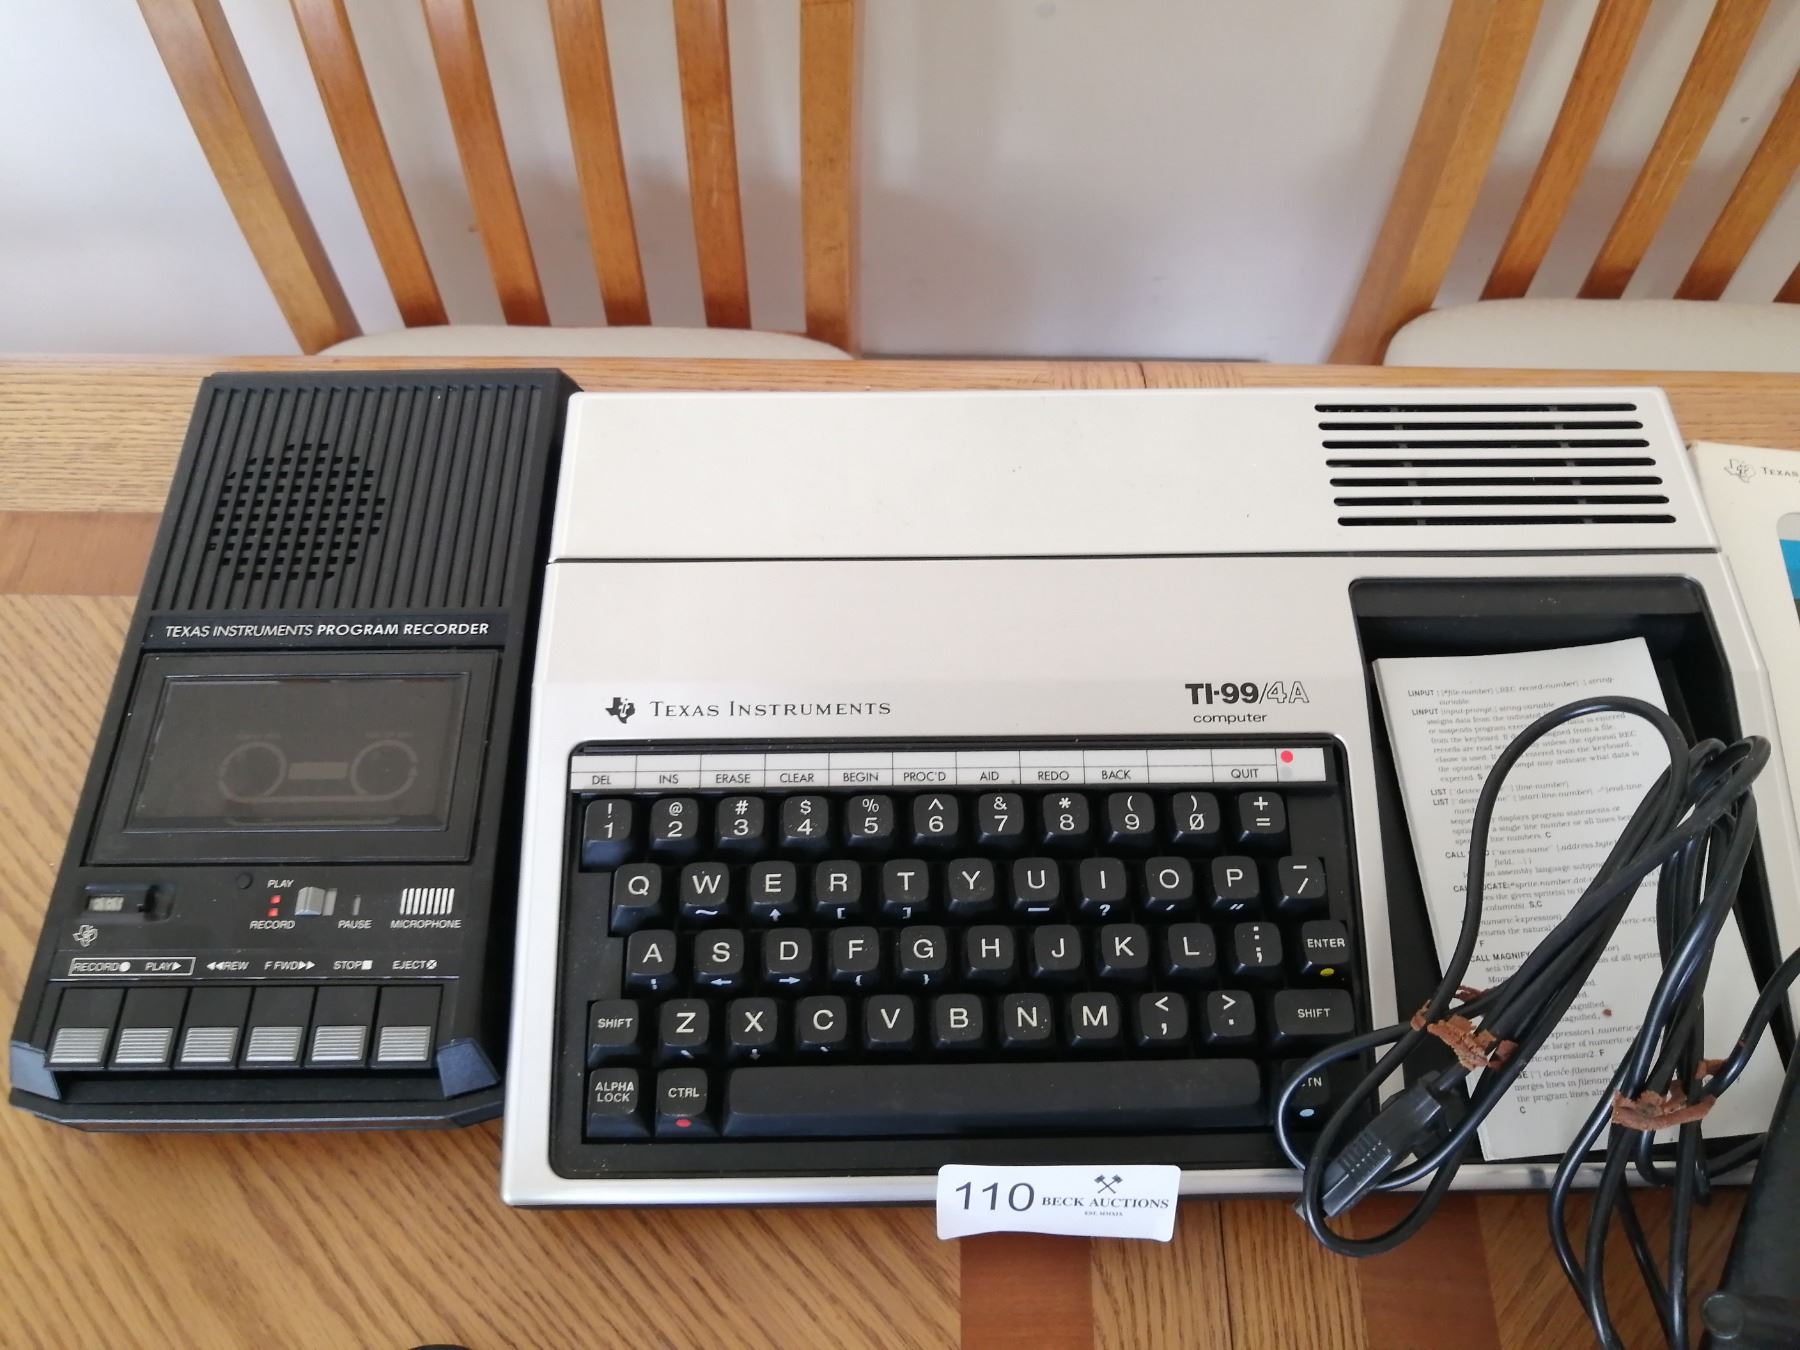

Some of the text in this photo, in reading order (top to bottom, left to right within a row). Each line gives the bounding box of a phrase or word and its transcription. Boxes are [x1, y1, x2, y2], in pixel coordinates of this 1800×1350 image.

[166, 623, 488, 637] TEXAS INSTRUMENTS PROGRAM RECORDER
[1185, 681, 1309, 705] TI-99/4A
[650, 701, 890, 716] TEXAS INSTRUMENTS
[1411, 708, 1439, 716] LINPUT
[1194, 714, 1267, 724] computer
[1612, 751, 1630, 759] data
[592, 775, 611, 785] DEL
[659, 774, 678, 784] INS
[716, 774, 750, 784] ERASE
[780, 773, 814, 783] CLEAR
[844, 772, 878, 782] BEGIN
[904, 772, 946, 782] PROC'D
[980, 772, 999, 781] AID
[1038, 771, 1069, 781] REDO
[1102, 770, 1131, 780] BACK
[1231, 769, 1258, 779] QUIT
[1430, 788, 1447, 796] LIST
[669, 802, 683, 816] @
[735, 800, 748, 814] #
[800, 800, 811, 815] $
[863, 799, 879, 812] %
[929, 799, 943, 810] ^
[994, 797, 1007, 810] &
[1127, 796, 1133, 811] (
[1191, 795, 1197, 811] )
[1254, 797, 1268, 810] +
[1433, 798, 1449, 806] LIST
[608, 803, 612, 818] !
[1531, 810, 1565, 821] program
[1566, 806, 1609, 817] statements
[668, 821, 682, 837] 2
[734, 819, 748, 835] 3
[797, 819, 812, 835] 4
[864, 817, 878, 833] 5
[929, 816, 943, 832] 6
[995, 815, 1008, 831] 7
[1060, 814, 1074, 830] 8
[1125, 814, 1139, 830] 9
[1256, 818, 1271, 826] =
[605, 823, 613, 838] 1
[1445, 850, 1466, 859] CALL
[267, 880, 294, 888] PLAY
[628, 876, 649, 895] Q
[693, 875, 721, 894] W
[765, 874, 781, 892] E
[829, 874, 847, 891] R
[897, 872, 914, 890] T
[962, 871, 980, 889] Y
[1028, 870, 1045, 889] U
[1100, 871, 1105, 889] I
[1160, 869, 1179, 888] O
[1227, 869, 1243, 887] P
[1298, 878, 1308, 894] /
[250, 920, 295, 929] RECORD
[338, 920, 372, 929] PAUSE
[390, 920, 461, 928] MICROPHONE
[780, 941, 798, 960] D
[849, 940, 864, 959] F
[913, 939, 933, 958] G
[982, 938, 999, 958] H
[1052, 938, 1064, 957] J
[1115, 937, 1134, 956] K
[1183, 937, 1200, 955] L
[1307, 938, 1345, 948] ENTER
[643, 944, 662, 963] A
[712, 942, 730, 962] S
[1256, 947, 1262, 963] ;
[1493, 951, 1531, 961] MAGNIFY
[1621, 953, 1632, 961] all
[74, 962, 118, 972] RECORD
[145, 962, 173, 971] PLAY
[224, 961, 249, 971] REW
[334, 960, 363, 970] STOP
[393, 959, 427, 970] EJECT
[1155, 996, 1168, 1011] <
[1222, 995, 1235, 1010] >
[813, 1010, 833, 1030] C
[881, 1008, 900, 1028] V
[950, 1008, 968, 1028] B
[1018, 1007, 1037, 1027] N
[1083, 1006, 1107, 1026] M
[1298, 1008, 1330, 1018] SHIFT
[598, 1018, 633, 1028] SHIFT
[676, 1013, 696, 1033] Z
[745, 1011, 763, 1032] X
[1599, 1048, 1606, 1057] F
[595, 1082, 634, 1092] ALPHA
[668, 1088, 699, 1098] CTRL
[1514, 1083, 1544, 1092] merges
[1545, 1080, 1566, 1089] lines
[597, 1093, 630, 1102] LOCK
[1533, 1092, 1568, 1104] program
[1570, 1090, 1590, 1098] lines
[1519, 1106, 1526, 1114] C
[956, 1182, 1034, 1211] 110
[1042, 1197, 1168, 1208] BECK AUCTIONS
